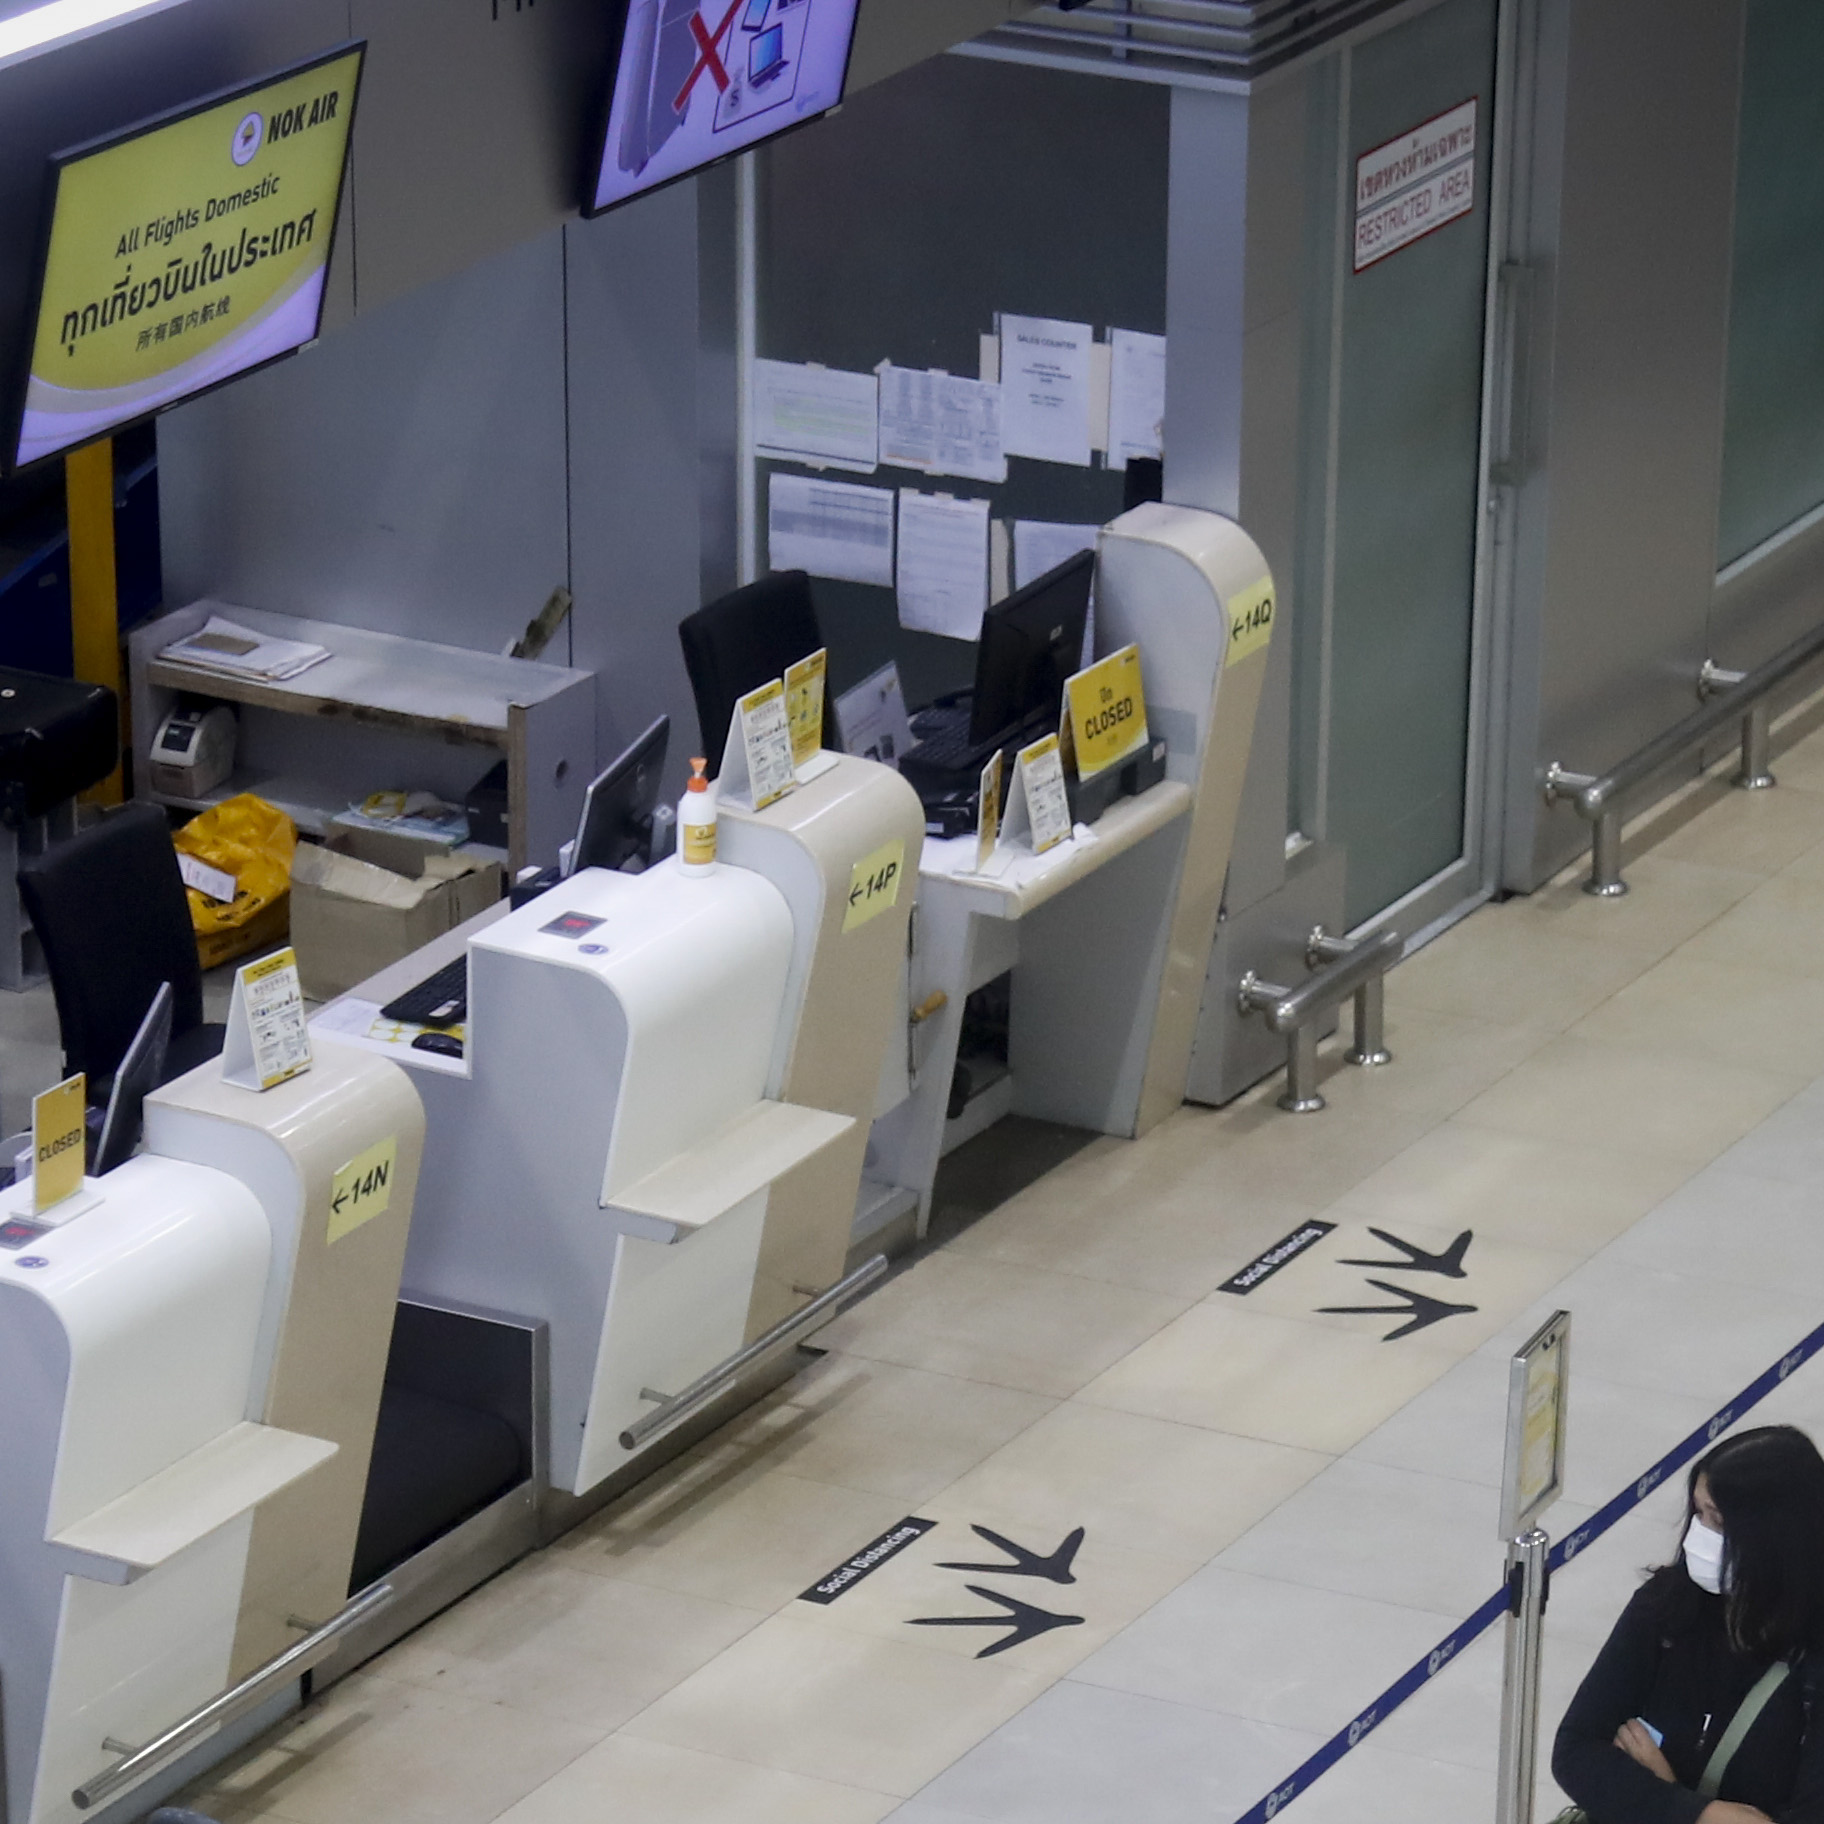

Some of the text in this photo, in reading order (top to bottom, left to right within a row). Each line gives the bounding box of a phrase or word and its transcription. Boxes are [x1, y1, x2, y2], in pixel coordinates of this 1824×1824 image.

[267, 91, 339, 144] NOK AIR
[115, 173, 280, 259] All Flights Domestic
[1358, 189, 1431, 246] RESTRICTED
[1439, 169, 1470, 206] AREA
[61, 208, 317, 357] ทุกเที่ยวบินในประเทศ
[1245, 598, 1272, 634] 14Q
[1085, 697, 1133, 740] CLOSED
[867, 861, 897, 899] 14P
[39, 1128, 81, 1162] CLOSED
[352, 1160, 389, 1204] 14N
[817, 1525, 921, 1594] Social Distancing
